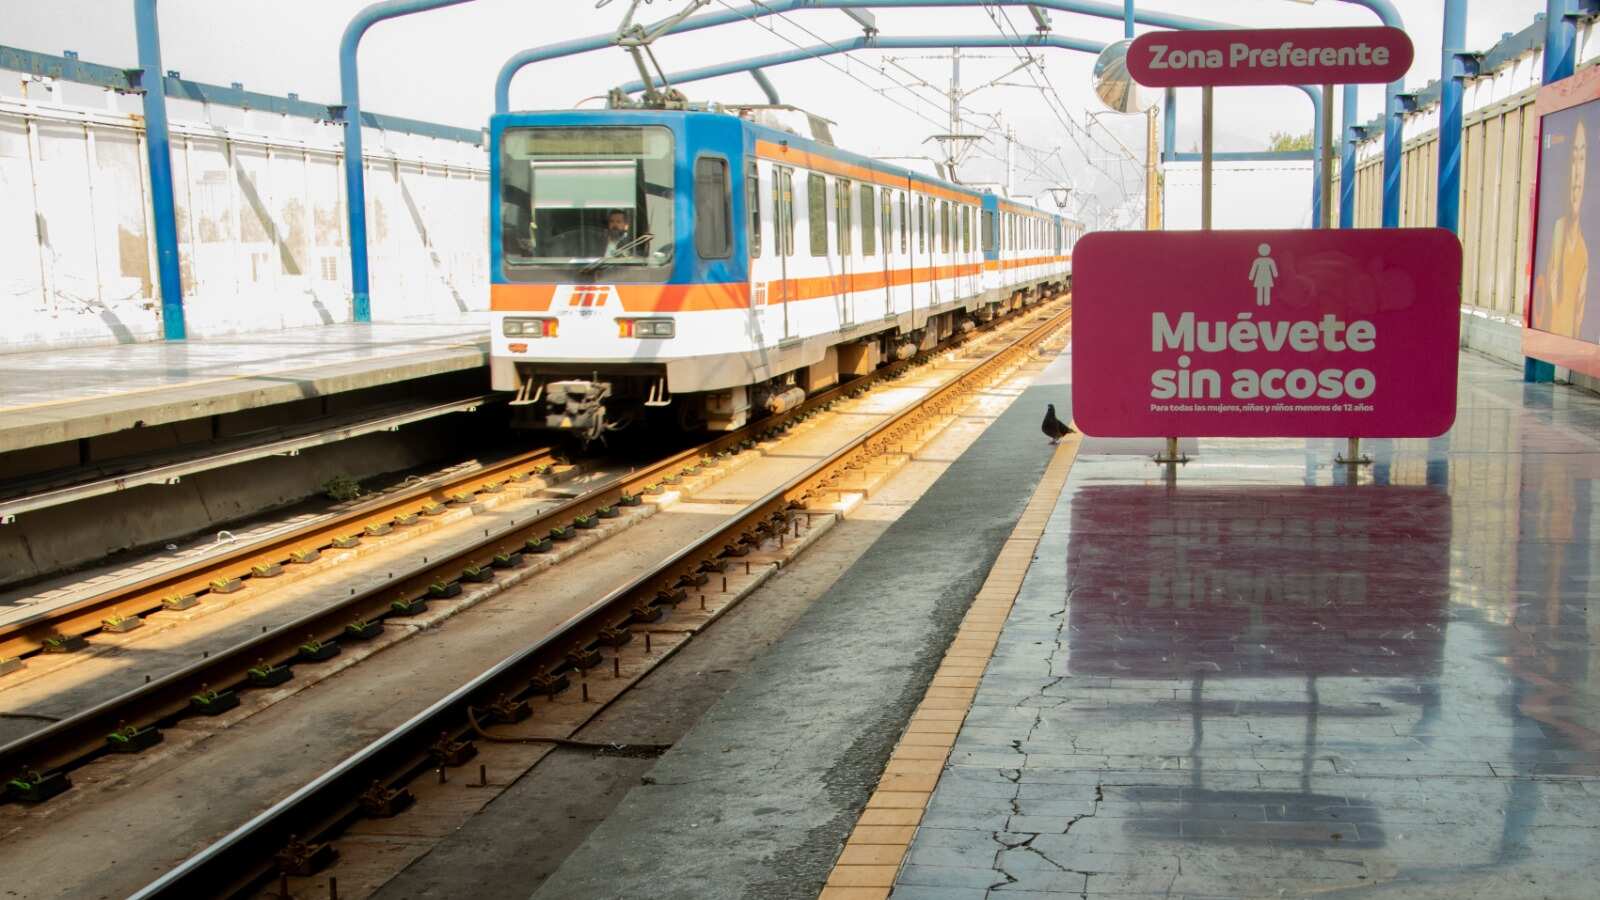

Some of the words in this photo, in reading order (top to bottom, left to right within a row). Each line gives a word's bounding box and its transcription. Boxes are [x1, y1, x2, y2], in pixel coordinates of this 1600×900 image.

[1149, 45, 1223, 69] Zona
[1229, 41, 1389, 68] Preferente
[1151, 311, 1376, 353] Muévete
[1151, 355, 1222, 399] sin
[1231, 368, 1376, 399] acoso
[1150, 404, 1169, 412] Para
[1170, 403, 1194, 412] todas
[1194, 403, 1206, 412] las
[1207, 404, 1242, 414] mujeres,
[1242, 403, 1264, 412] niñas
[1272, 403, 1294, 412] niños
[1295, 404, 1331, 412] menores
[1332, 404, 1342, 412] de
[1343, 404, 1353, 412] 12
[1354, 403, 1373, 412] años
